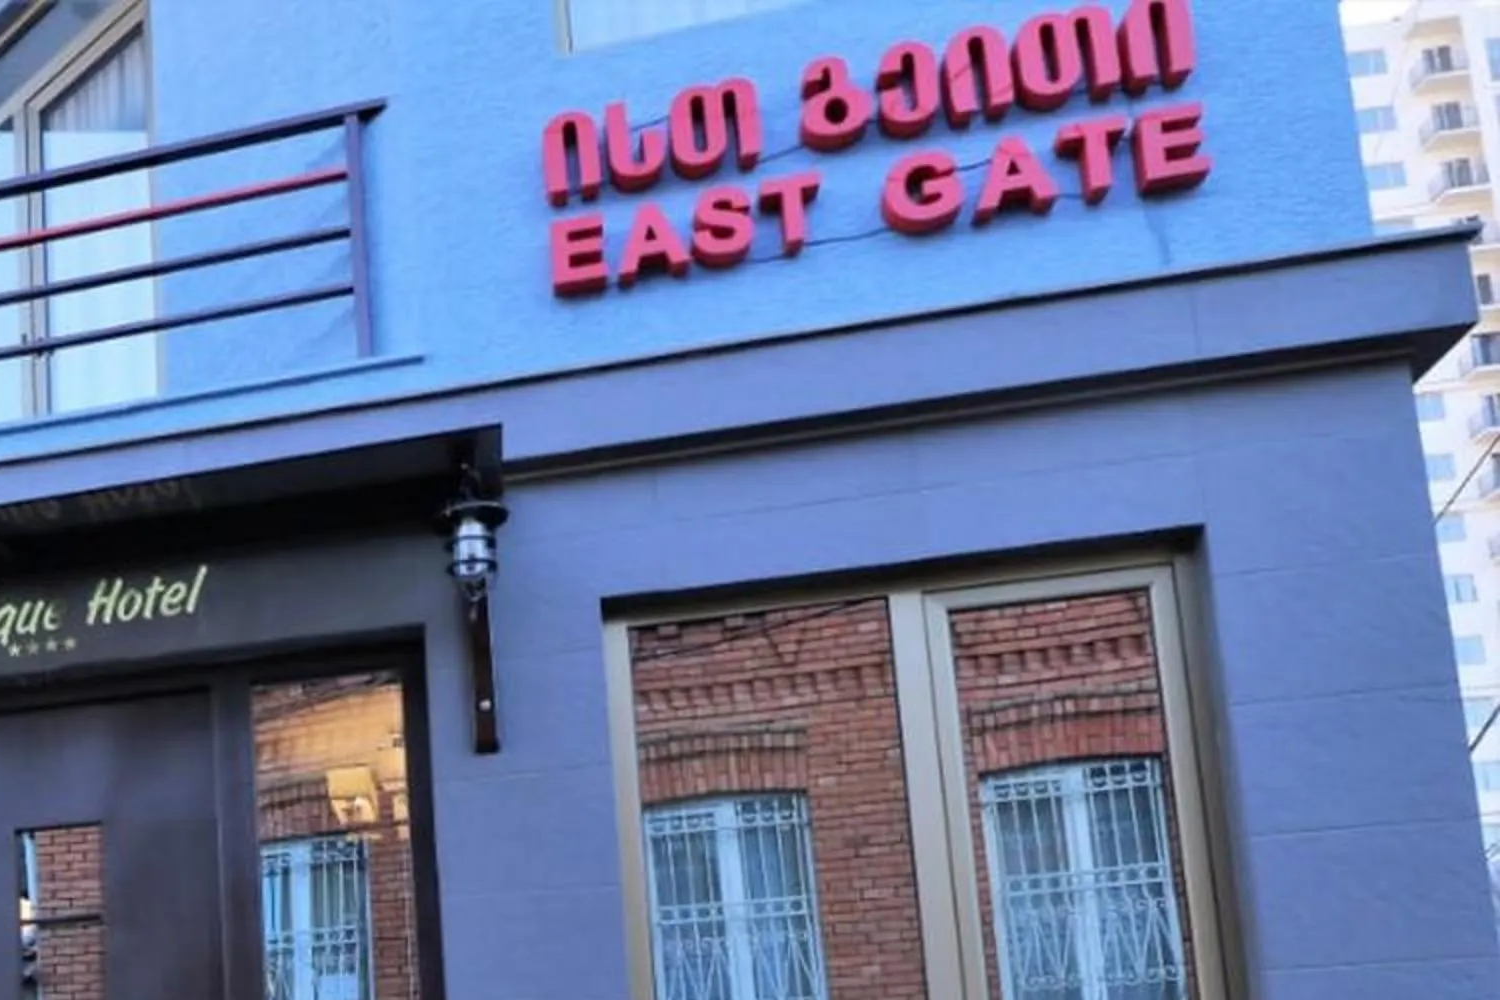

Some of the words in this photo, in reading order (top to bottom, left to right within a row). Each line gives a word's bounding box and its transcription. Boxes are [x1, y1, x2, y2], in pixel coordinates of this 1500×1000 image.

[543, 77, 760, 208] ისთ
[801, 0, 1193, 151] გეითი
[551, 172, 820, 298] EAST
[882, 103, 1212, 236] GATE
[86, 564, 208, 626] Hotel
